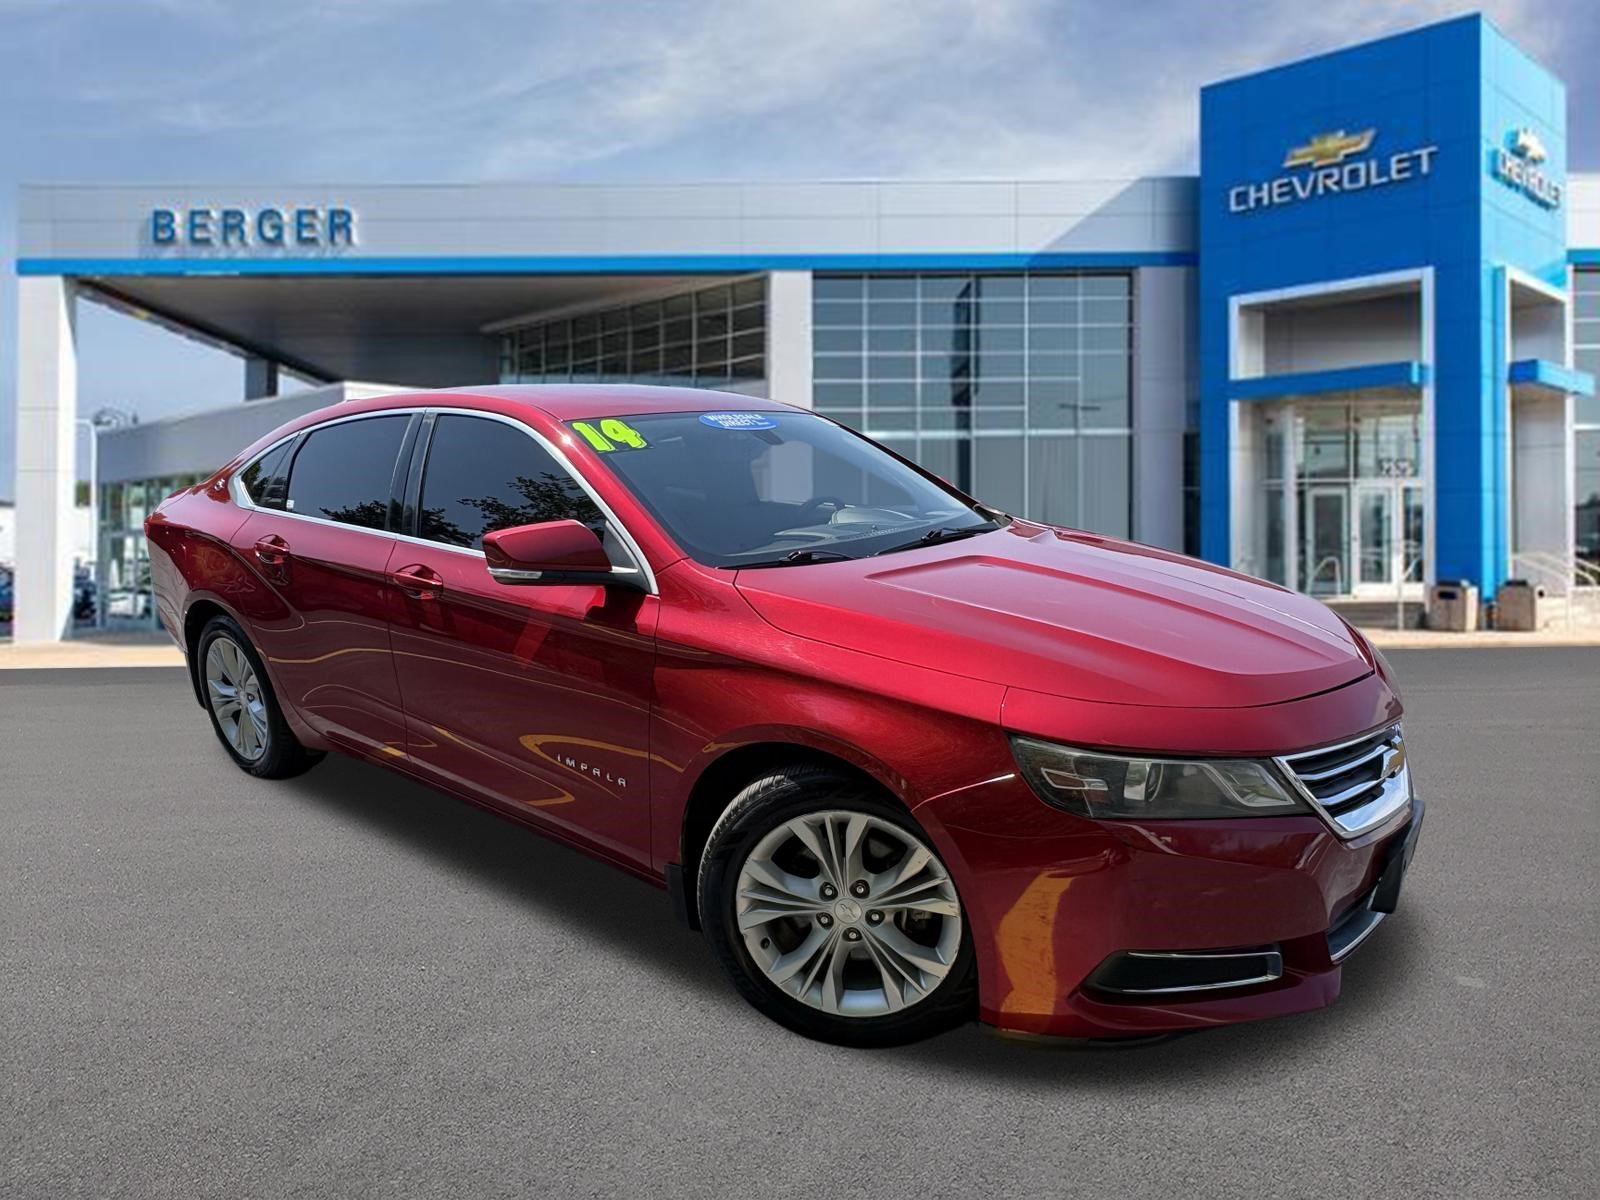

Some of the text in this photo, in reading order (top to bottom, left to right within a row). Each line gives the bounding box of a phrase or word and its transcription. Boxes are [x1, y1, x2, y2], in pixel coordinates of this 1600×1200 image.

[1229, 145, 1438, 213] CHEVROLET
[151, 207, 355, 245] BERGER
[572, 419, 648, 452] 14
[556, 753, 627, 788] IMPALA
